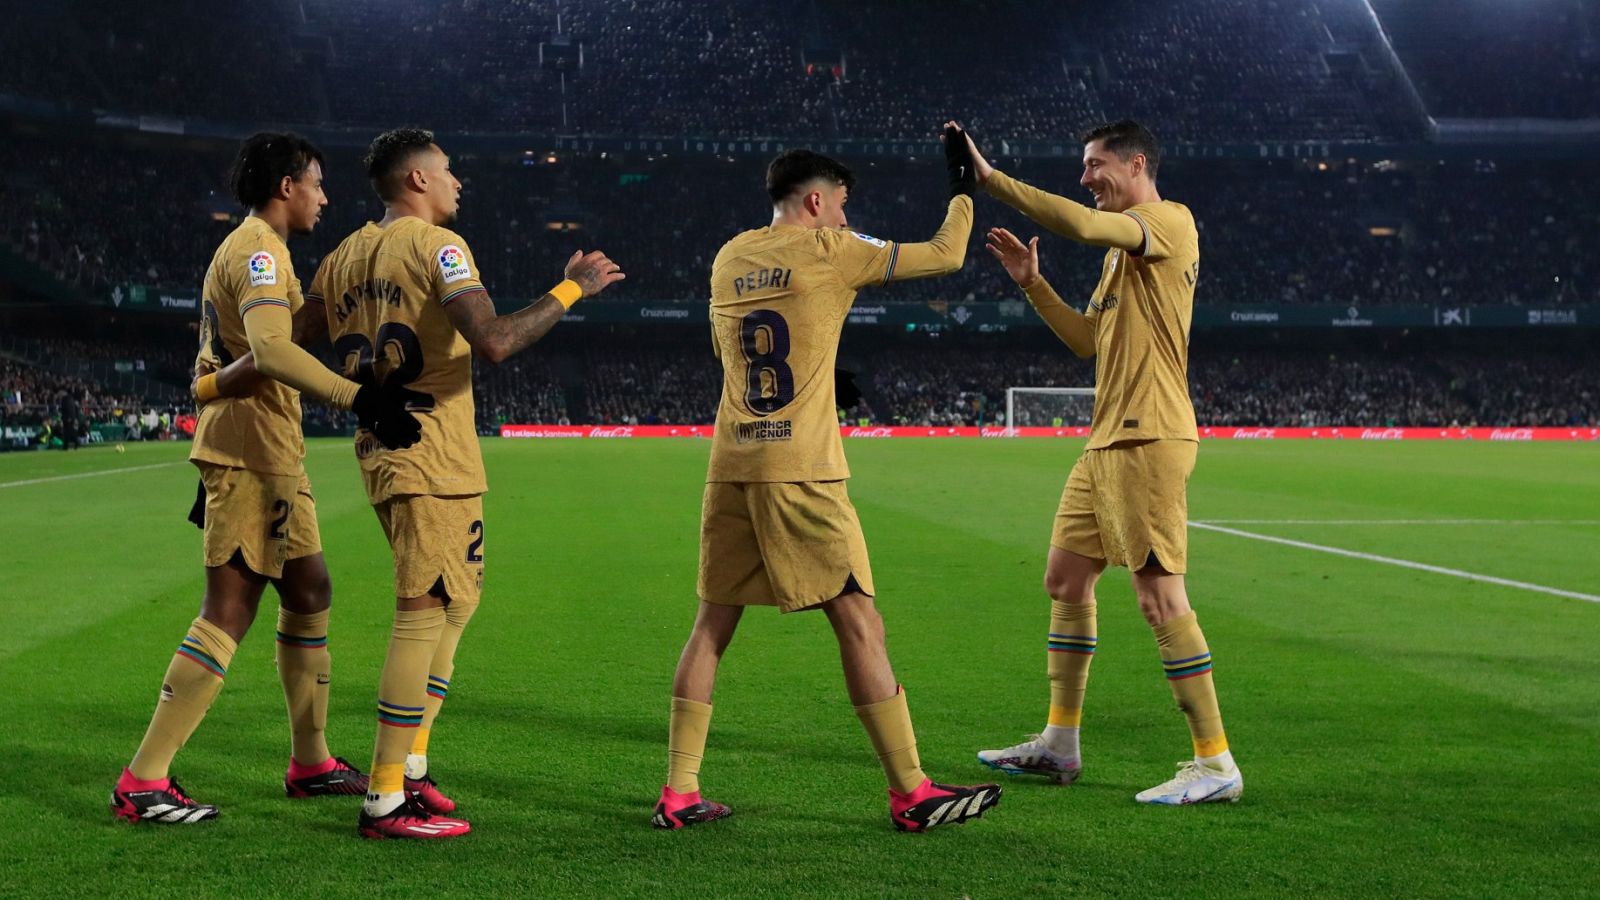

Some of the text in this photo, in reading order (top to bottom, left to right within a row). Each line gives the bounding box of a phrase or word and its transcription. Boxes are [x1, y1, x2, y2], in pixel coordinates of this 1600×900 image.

[683, 140, 784, 153] leyenda
[863, 143, 941, 154] recorr
[1260, 145, 1330, 157] BETIS
[252, 273, 274, 282] LaLiga
[444, 268, 468, 279] LaLiga
[734, 267, 792, 297] PEDRI
[640, 307, 689, 319] Cruzcampo
[1231, 311, 1279, 322] Cruzcampo
[738, 309, 795, 417] 8
[754, 420, 792, 430] UNHCR
[543, 430, 583, 438] Santander
[756, 429, 792, 440] ACNUR
[270, 499, 291, 540] 2
[465, 519, 484, 564] 2
